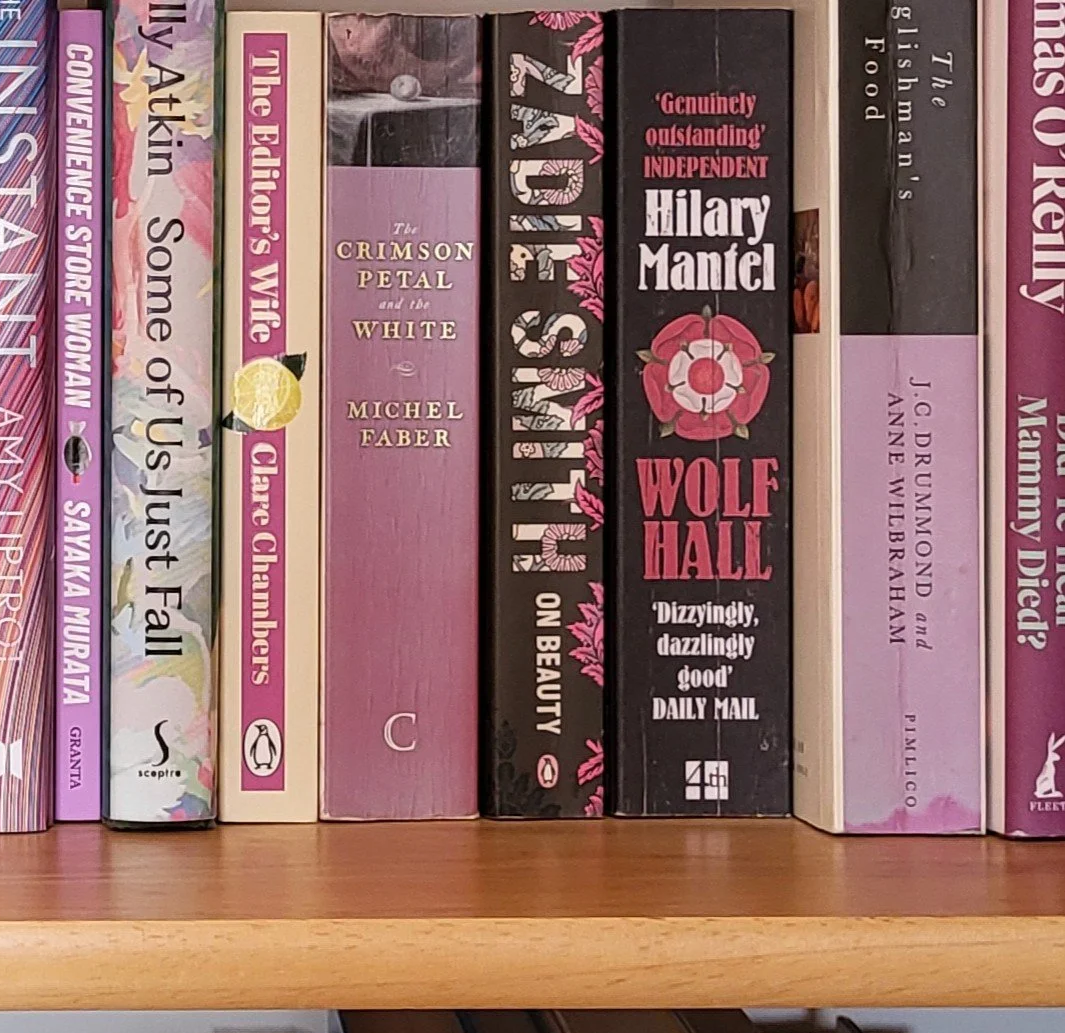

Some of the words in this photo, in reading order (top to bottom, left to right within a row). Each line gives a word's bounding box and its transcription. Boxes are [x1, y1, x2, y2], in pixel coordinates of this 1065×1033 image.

[248, 49, 281, 118] The
[865, 37, 885, 121] Food
[65, 43, 93, 222] CONVENIENCE
[146, 60, 185, 177] Atkin
[248, 124, 281, 256] Editor's
[509, 53, 584, 282] ZADIE
[644, 156, 768, 178] INDEPENDENT
[336, 241, 474, 261] CRIMSON
[644, 189, 771, 245] Hilary
[65, 226, 92, 304] STORE
[146, 216, 185, 343] Some
[357, 270, 453, 289] PETAL
[638, 243, 775, 291] Mantel
[248, 260, 281, 344] Wife
[352, 321, 458, 340] WHITE
[64, 310, 91, 408] WOMAN
[146, 356, 185, 406] of
[145, 417, 183, 472] Us
[347, 401, 463, 420] MICHEL
[359, 429, 451, 448] FABER
[510, 309, 587, 572] SMITH
[888, 393, 905, 465] ANNE
[250, 442, 278, 526] Clare
[636, 458, 779, 517] WOLF
[63, 500, 91, 597] SAYAKA
[141, 478, 183, 569] Just
[643, 520, 772, 580] HALL
[888, 477, 906, 645] WILBRAHAM
[145, 585, 183, 657] Fall
[250, 531, 278, 685] Chambers
[536, 592, 561, 628] ON
[915, 612, 933, 650] and
[63, 606, 90, 705] MURATA
[536, 635, 562, 735] BEAUTY
[652, 698, 706, 720] DAILY
[714, 698, 759, 720] MAIL
[69, 726, 82, 790] GRANTA
[138, 768, 182, 778] sceptre
[905, 714, 916, 808] PIMLICO
